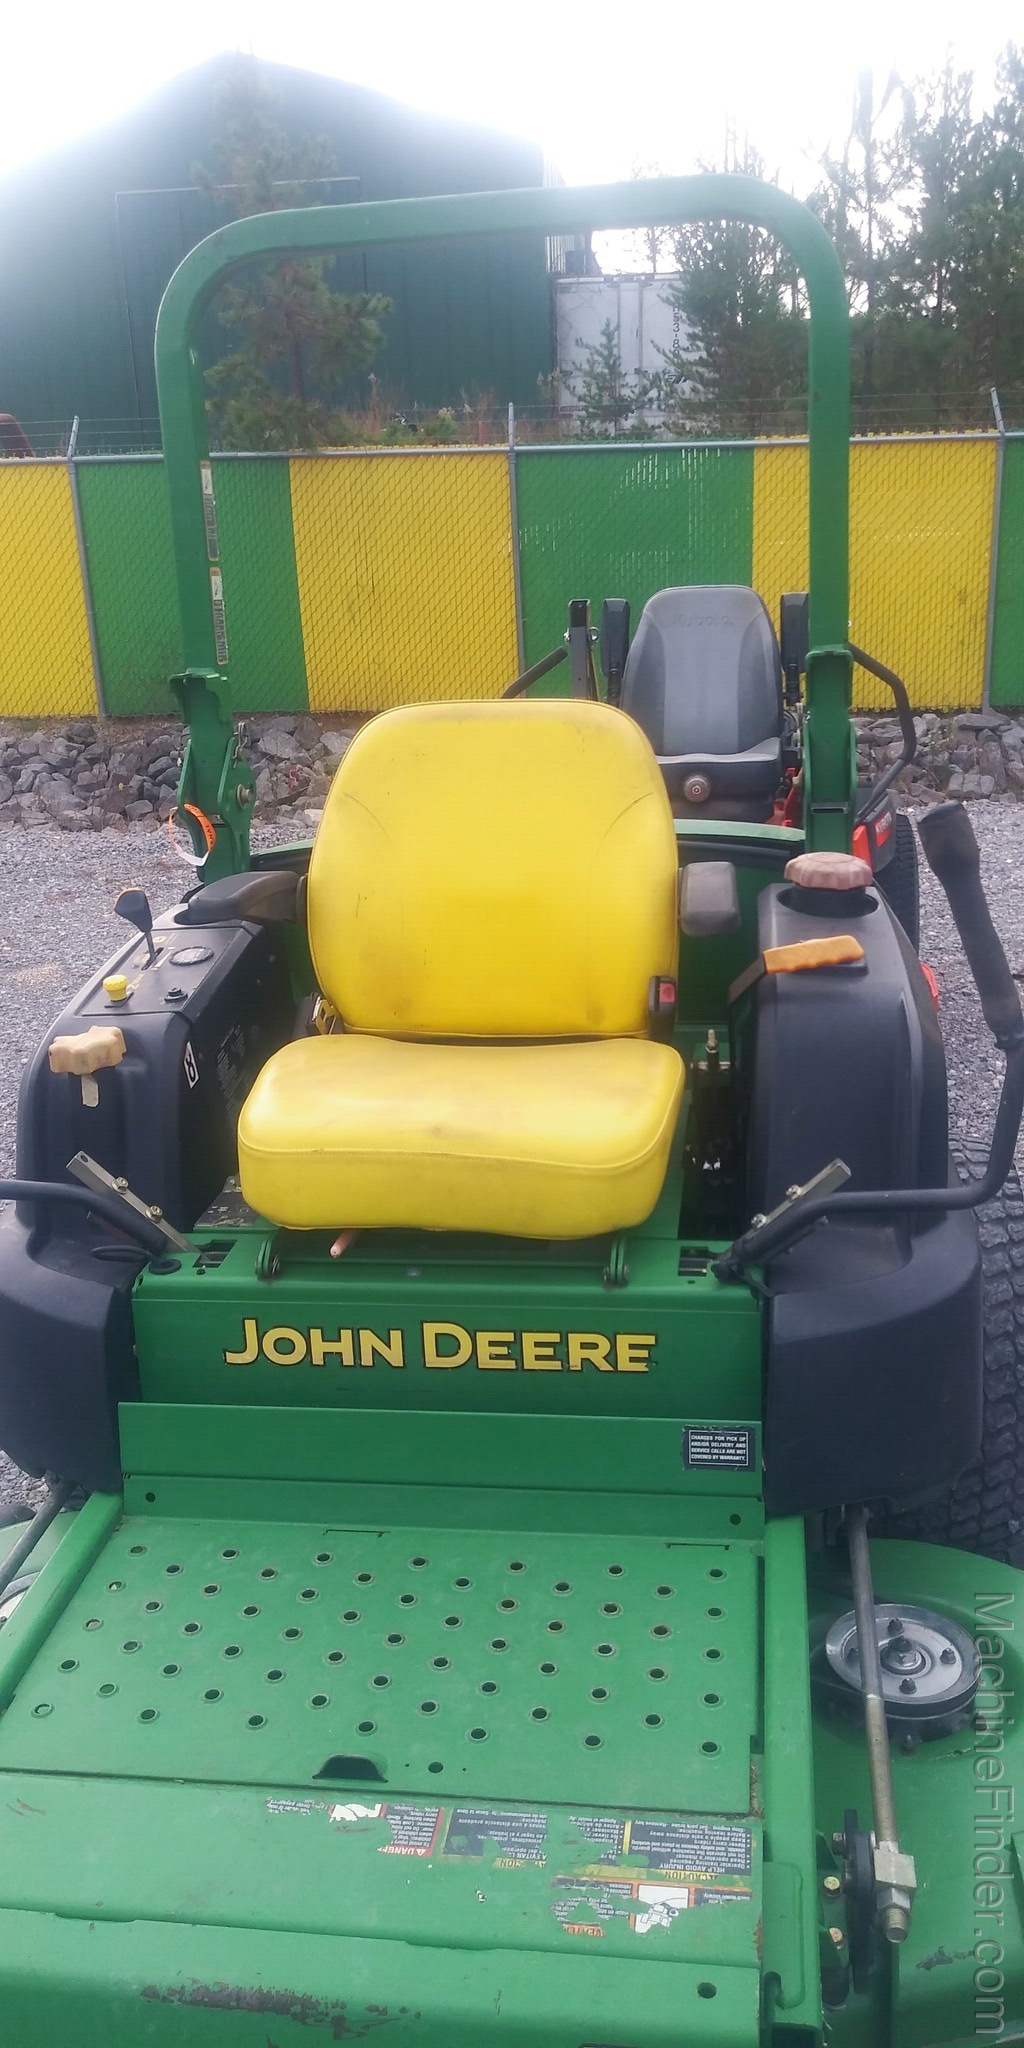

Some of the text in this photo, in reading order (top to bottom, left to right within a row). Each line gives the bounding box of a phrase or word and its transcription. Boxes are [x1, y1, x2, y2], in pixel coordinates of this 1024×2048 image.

[224, 1317, 657, 1373] JOHN DEERE
[665, 1871, 708, 1880] CAUTION
